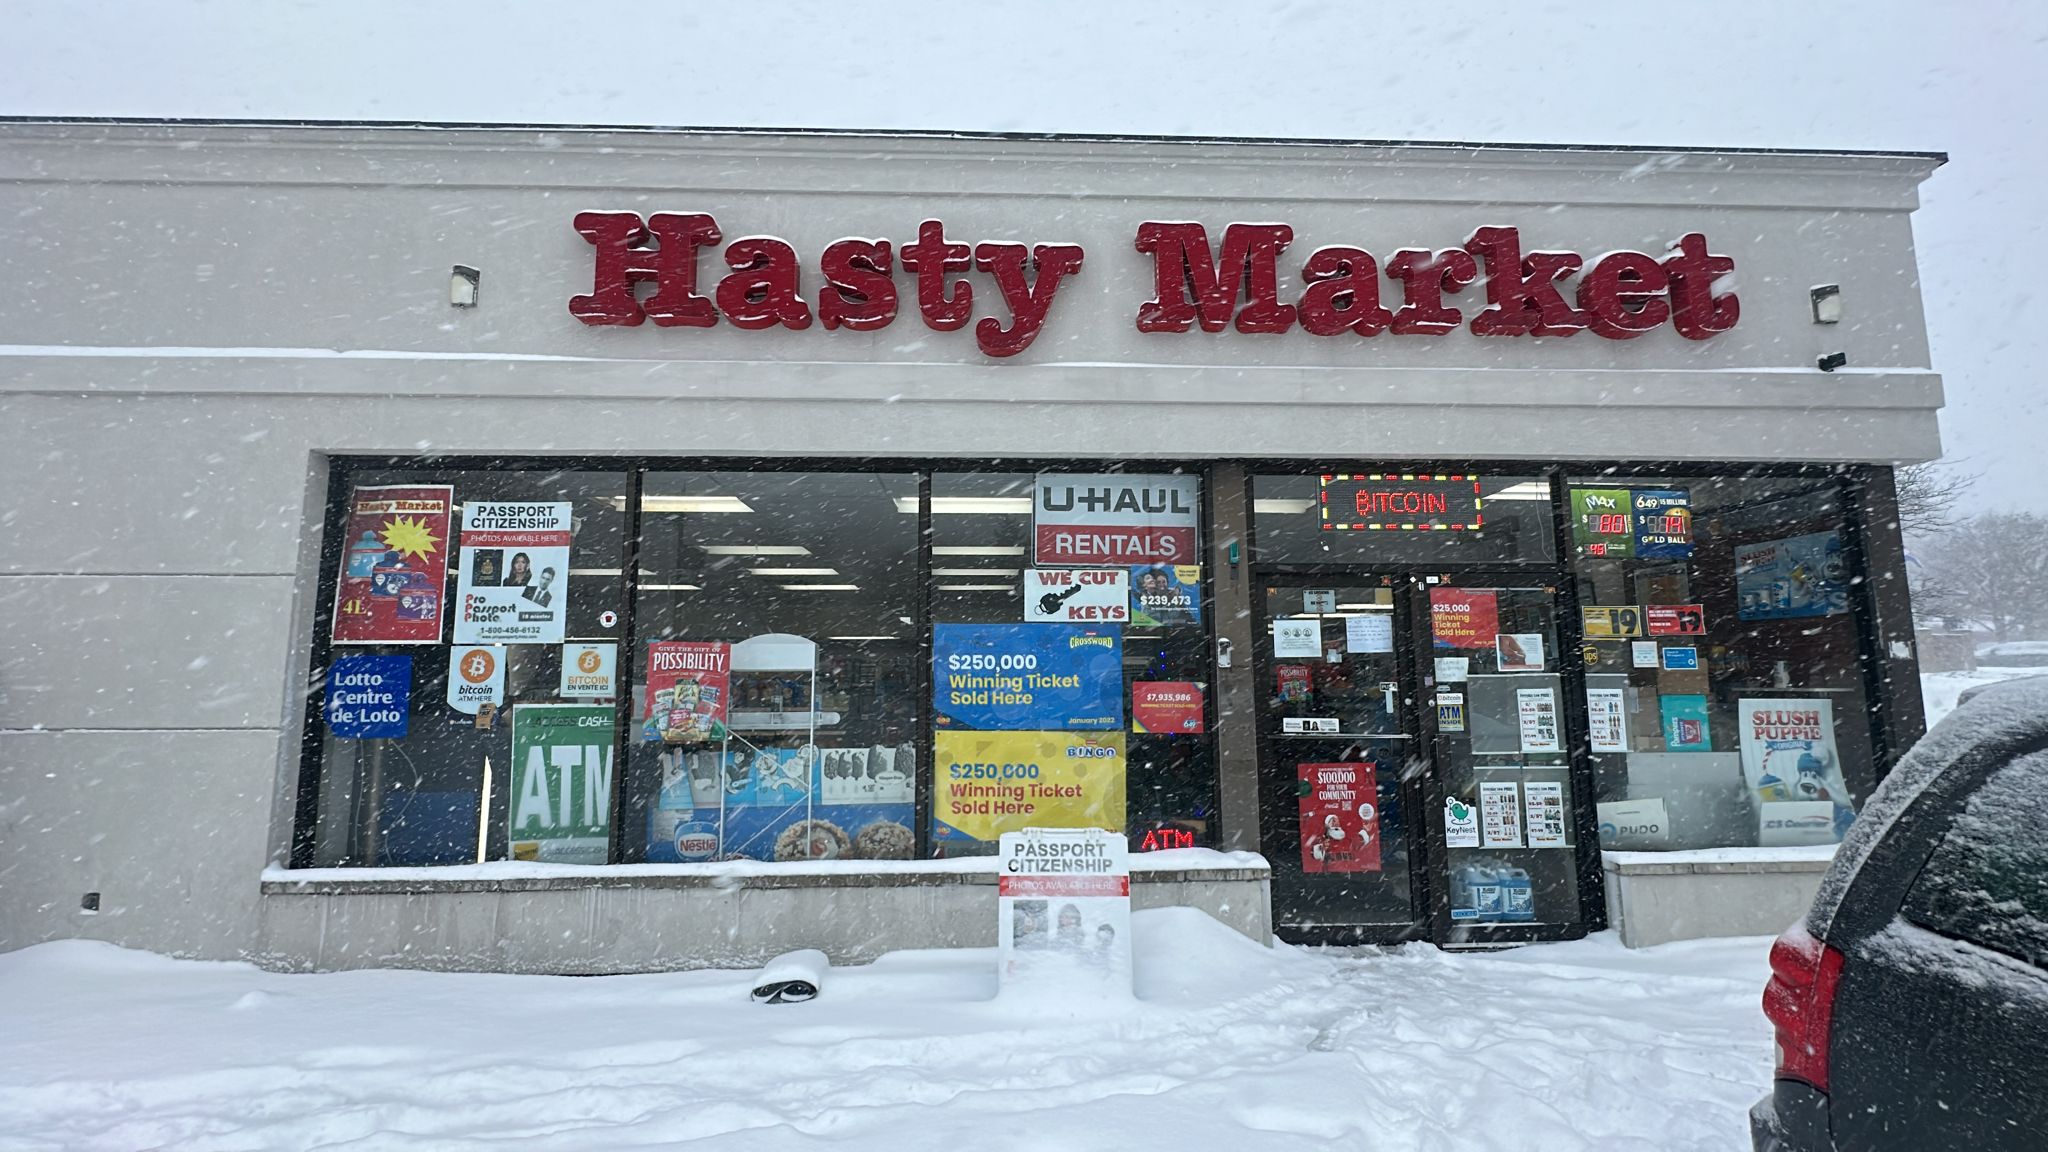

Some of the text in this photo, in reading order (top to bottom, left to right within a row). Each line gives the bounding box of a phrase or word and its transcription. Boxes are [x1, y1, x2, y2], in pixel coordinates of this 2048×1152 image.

[569, 210, 1740, 357] Hasty Market
[358, 501, 442, 513] Hasty Market
[477, 506, 555, 517] PASSPORT
[471, 518, 559, 529] CITIZENSHIP
[1055, 534, 1176, 555] RENTALS
[1038, 572, 1119, 585] WE CUT
[465, 594, 486, 604] Pro
[1140, 595, 1191, 606] $239,473
[465, 603, 516, 615] Passport
[1069, 606, 1125, 620] KEYS
[1433, 604, 1470, 613] $25,000
[464, 613, 501, 622] Photo
[1434, 613, 1470, 623] Winning
[1609, 609, 1637, 634] 19
[1070, 636, 1113, 648] CROSSWORD
[653, 652, 725, 672] POSSIBILITY
[949, 654, 1036, 671] $250,000
[334, 672, 383, 686] Lotto
[568, 676, 608, 684] BITCOIN
[949, 674, 1080, 690] Winning Ticket
[458, 685, 493, 695] bitcoin
[333, 689, 393, 705] Centre
[951, 691, 1033, 705] Sold Here
[1146, 694, 1191, 702] $7,935,986
[331, 709, 401, 723] de Loto
[1440, 707, 1460, 719] ATM
[1752, 710, 1820, 726] SLUSH
[579, 716, 610, 727] CASH
[1066, 746, 1117, 758] BINGO
[949, 763, 1039, 781] $250,000
[1318, 772, 1356, 784] $100,000
[514, 744, 614, 829] ATM
[950, 783, 1082, 801] Winning Ticket
[1319, 790, 1356, 800] COMMUNITY
[951, 800, 1035, 815] Sold Here
[1447, 826, 1477, 835] KeyNest
[1620, 824, 1659, 835] PUDO
[1142, 829, 1194, 850] ATM
[1015, 843, 1106, 857] PASSPORT
[1008, 859, 1113, 872] CITIZENSHIP
